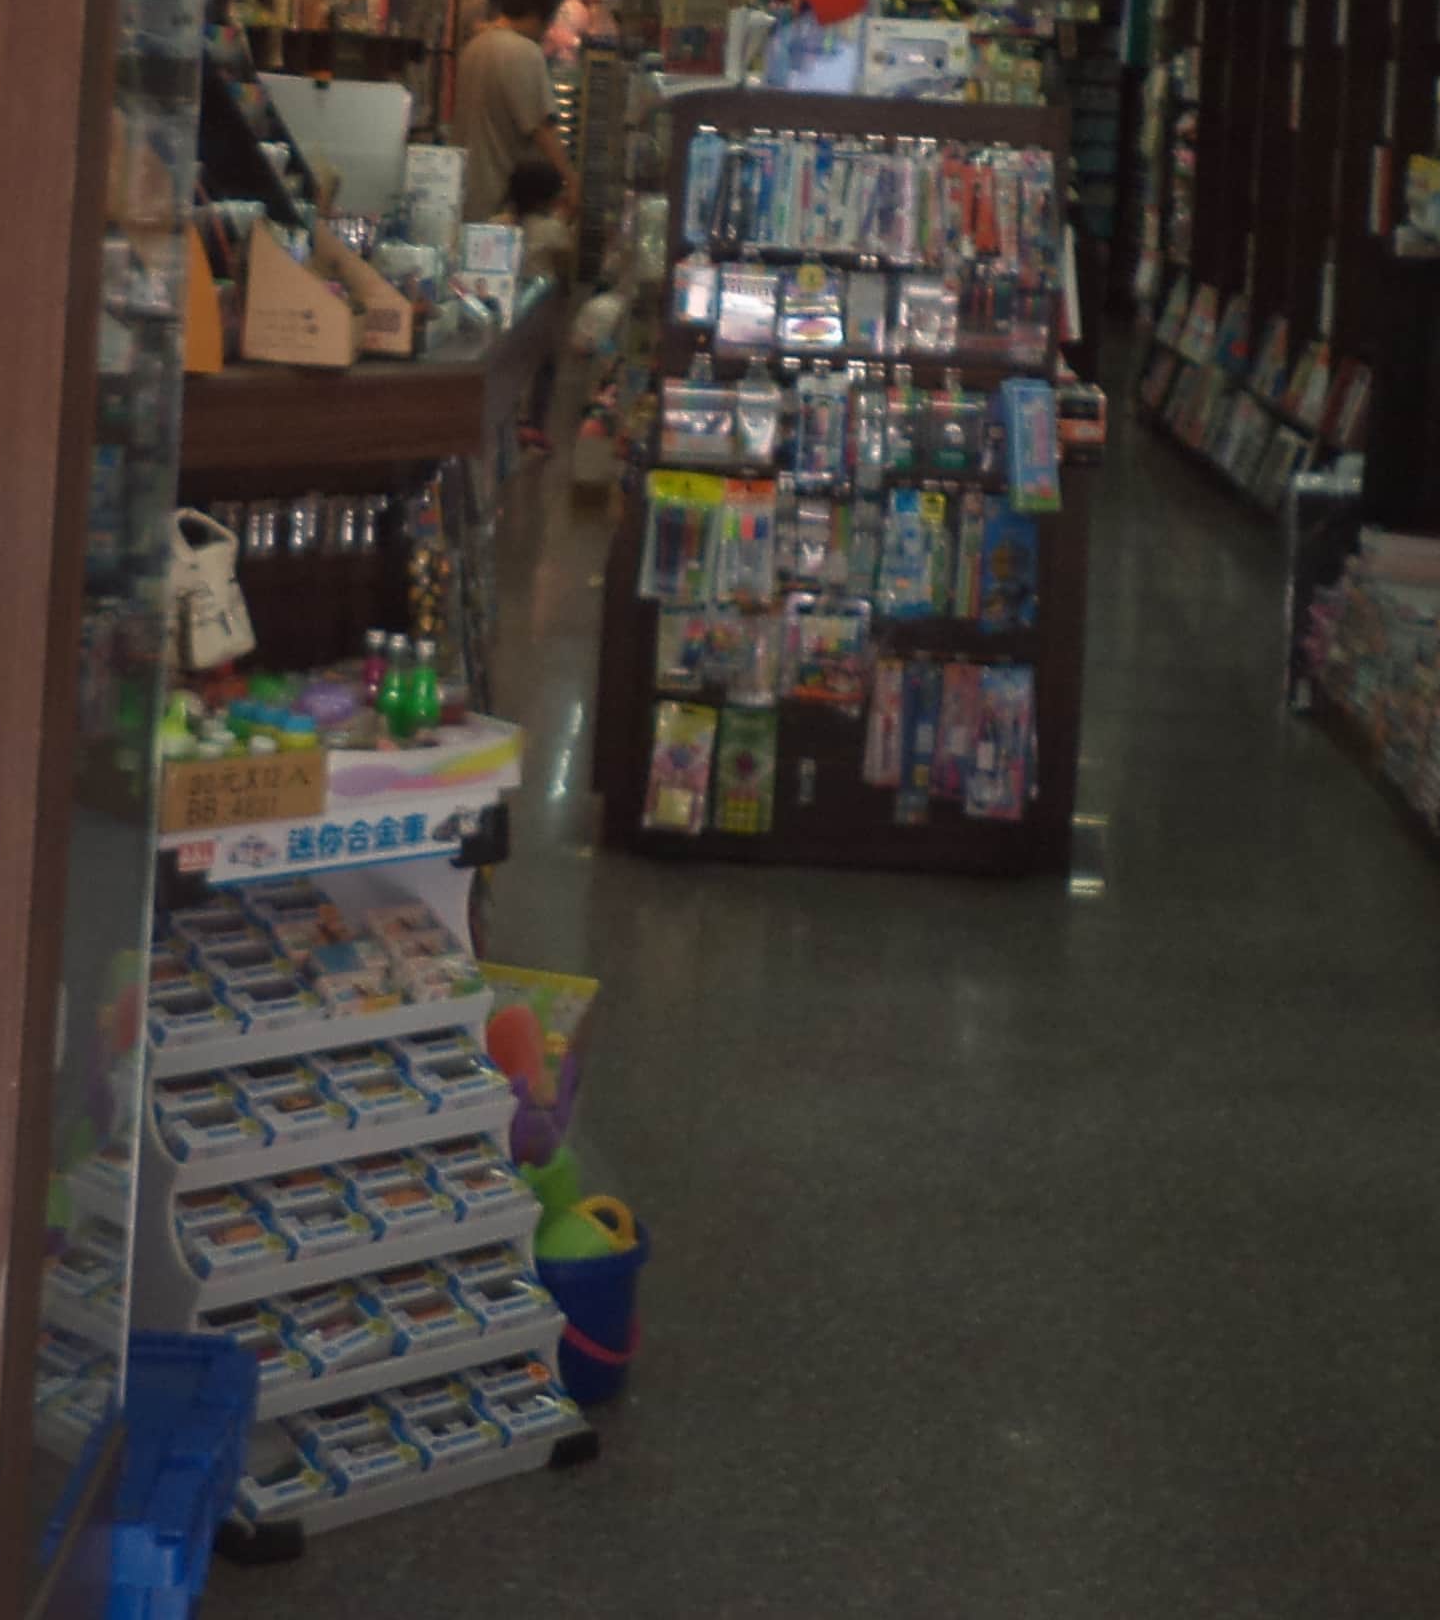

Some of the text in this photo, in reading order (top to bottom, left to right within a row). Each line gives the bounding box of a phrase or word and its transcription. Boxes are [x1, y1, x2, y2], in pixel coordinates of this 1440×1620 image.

[286, 811, 429, 863] 迷你合金車
